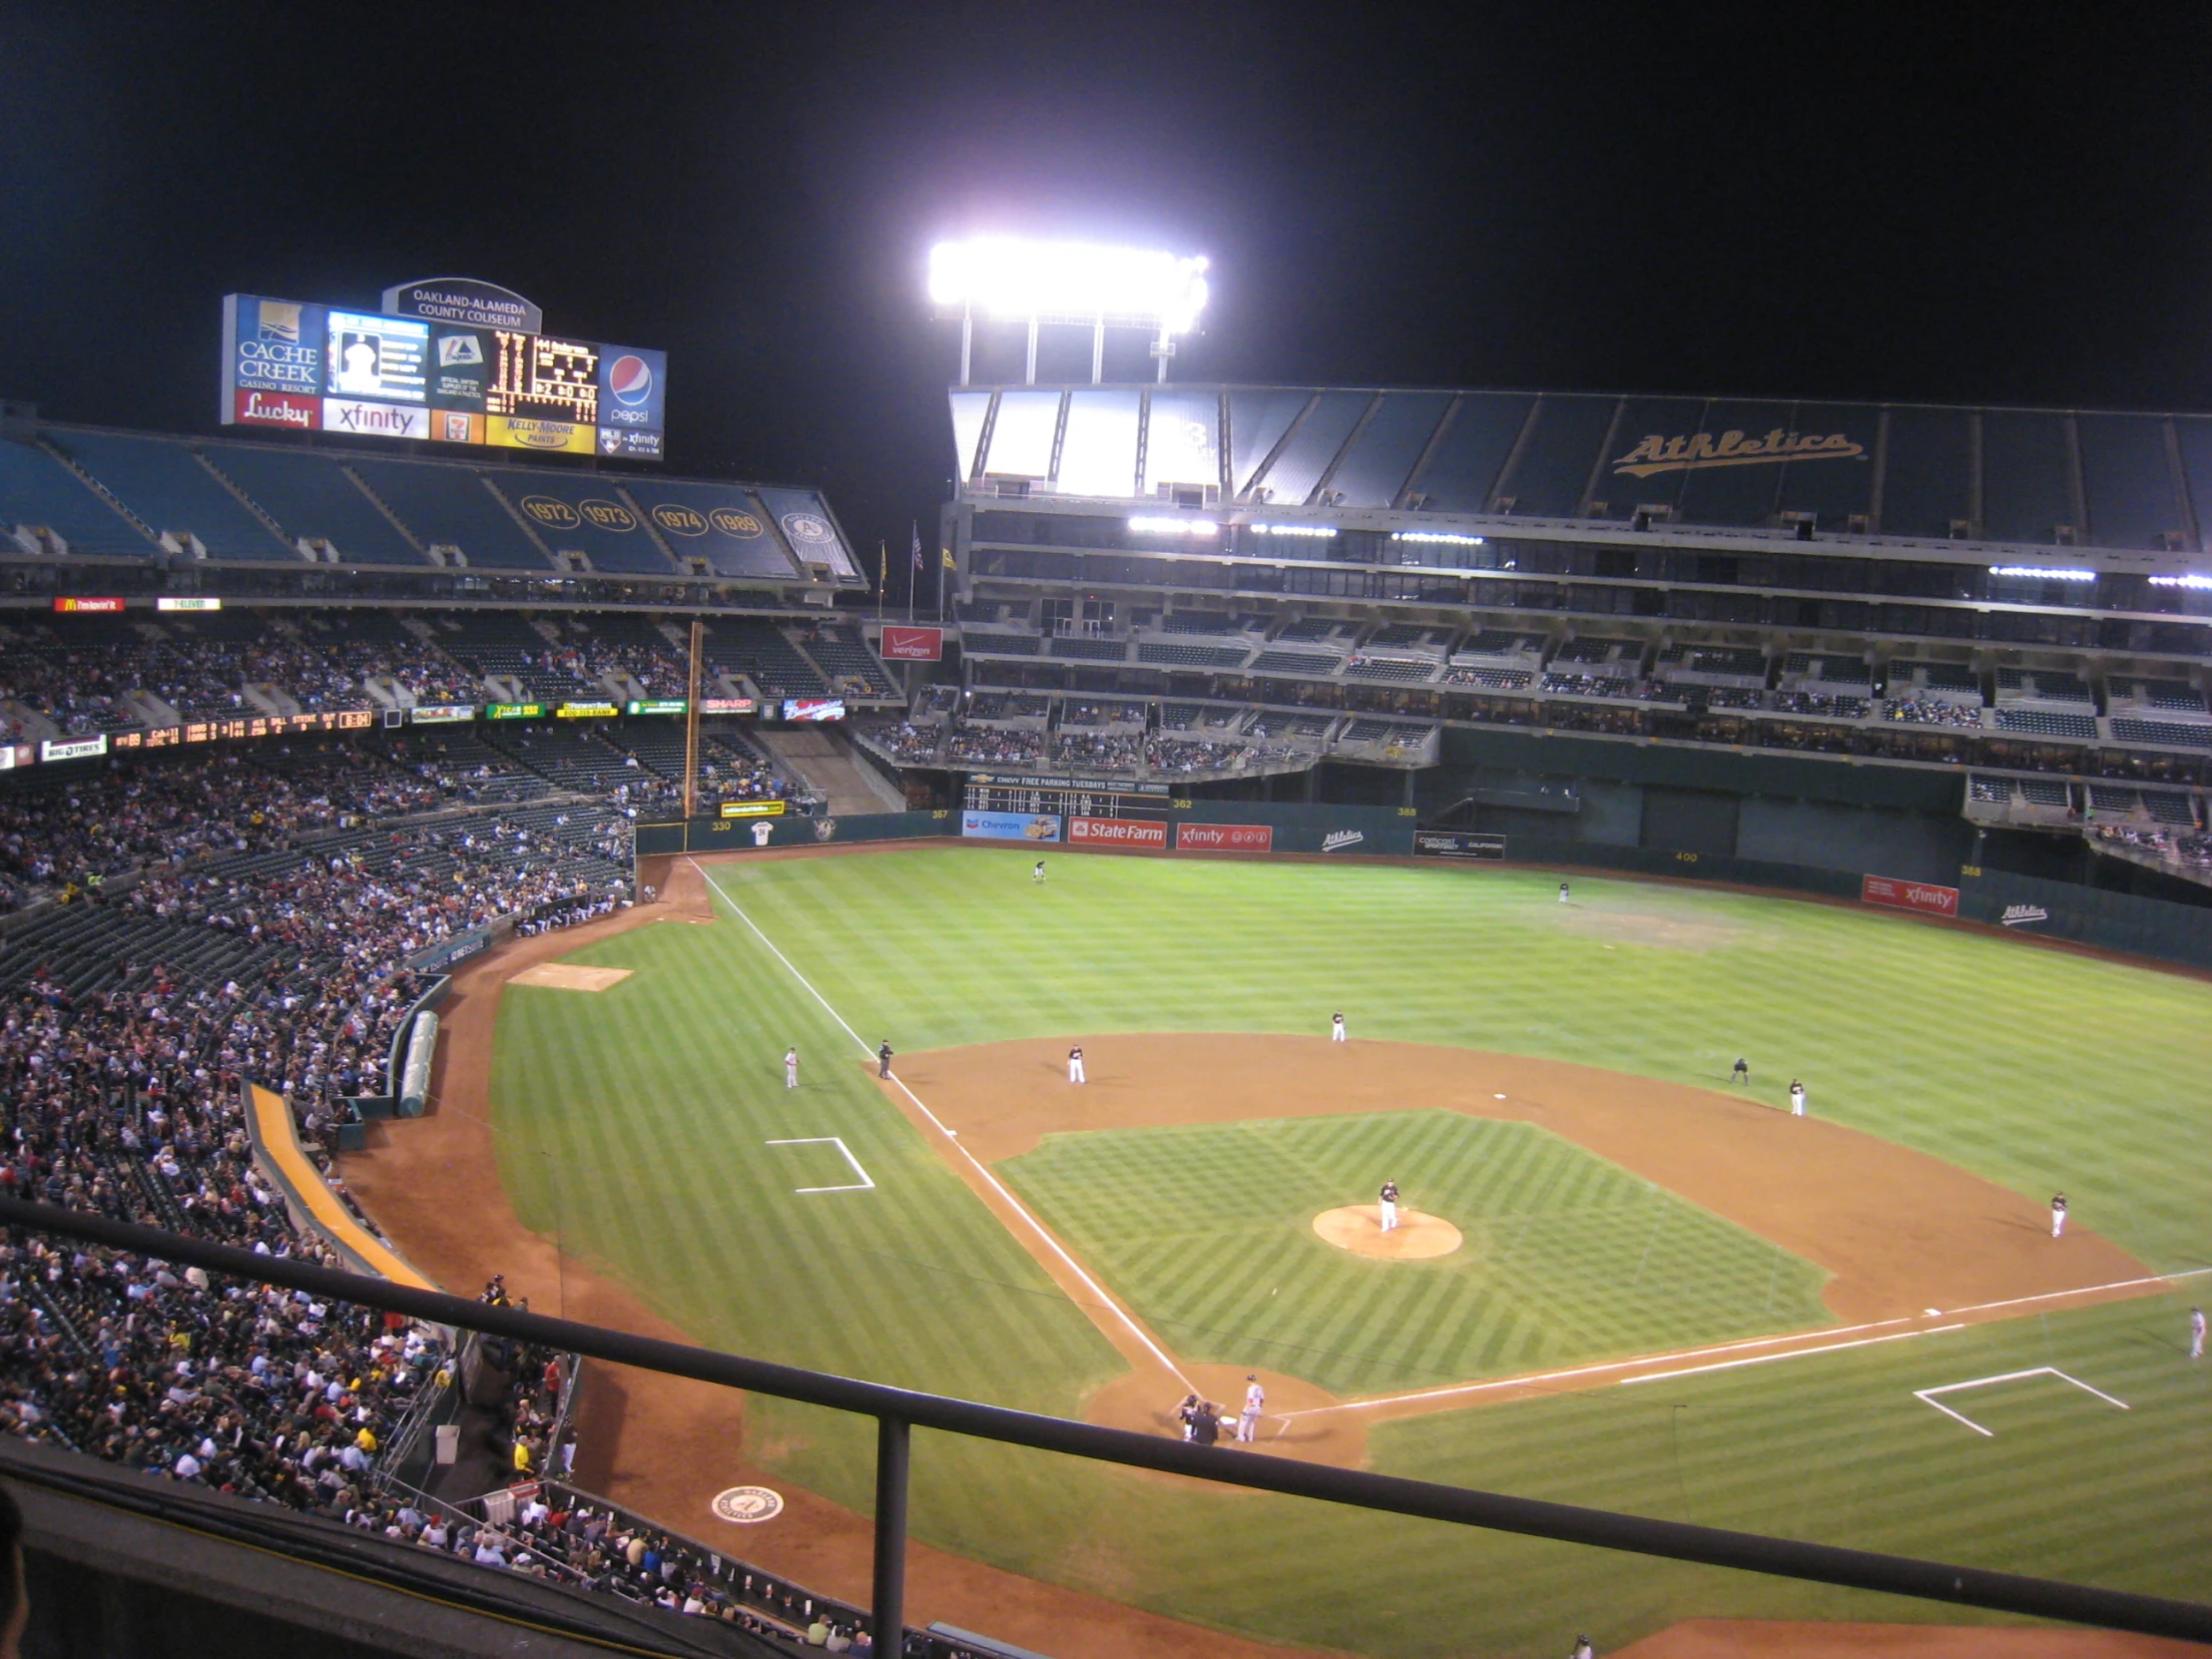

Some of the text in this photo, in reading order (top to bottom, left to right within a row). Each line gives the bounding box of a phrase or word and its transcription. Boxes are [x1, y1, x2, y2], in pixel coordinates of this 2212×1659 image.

[413, 289, 526, 316] OAKLAND-ALAMEDA
[418, 303, 521, 326] COUNTY COLISEUM
[240, 340, 317, 365] CACHE
[240, 359, 317, 384] CREEK
[240, 379, 317, 394] CASINO RESORT
[244, 392, 309, 428] Lucky
[611, 409, 649, 423] pepsi
[339, 404, 414, 435] xfinity
[507, 419, 575, 435] KELLY-MOORE
[528, 434, 555, 443] PAINTS
[629, 432, 660, 446] xfinity
[1613, 427, 1863, 478] Athletics
[527, 503, 575, 521] 1972
[584, 506, 631, 524] 1973
[659, 511, 702, 528] 1974
[716, 514, 759, 532] 1989
[892, 646, 930, 656] verizon
[706, 699, 752, 709] SHARP
[785, 699, 842, 721] Budweiser
[271, 717, 287, 726] BALL
[291, 714, 317, 724] STRIKE
[322, 713, 336, 722] OUT
[48, 748, 64, 757] BIG
[75, 744, 101, 753] TIRES
[1071, 780, 1106, 790] TUESDAYS
[1174, 800, 1192, 810] 362
[1397, 808, 1416, 817] 388
[931, 810, 948, 820] 367
[712, 822, 732, 831] 330
[981, 820, 1020, 830] Chevron
[1182, 828, 1224, 843] xfinity
[1322, 830, 1364, 852] Athletics
[1960, 865, 1980, 876] 388
[1906, 886, 1952, 908] xfinity
[2001, 904, 2047, 925] Athletics
